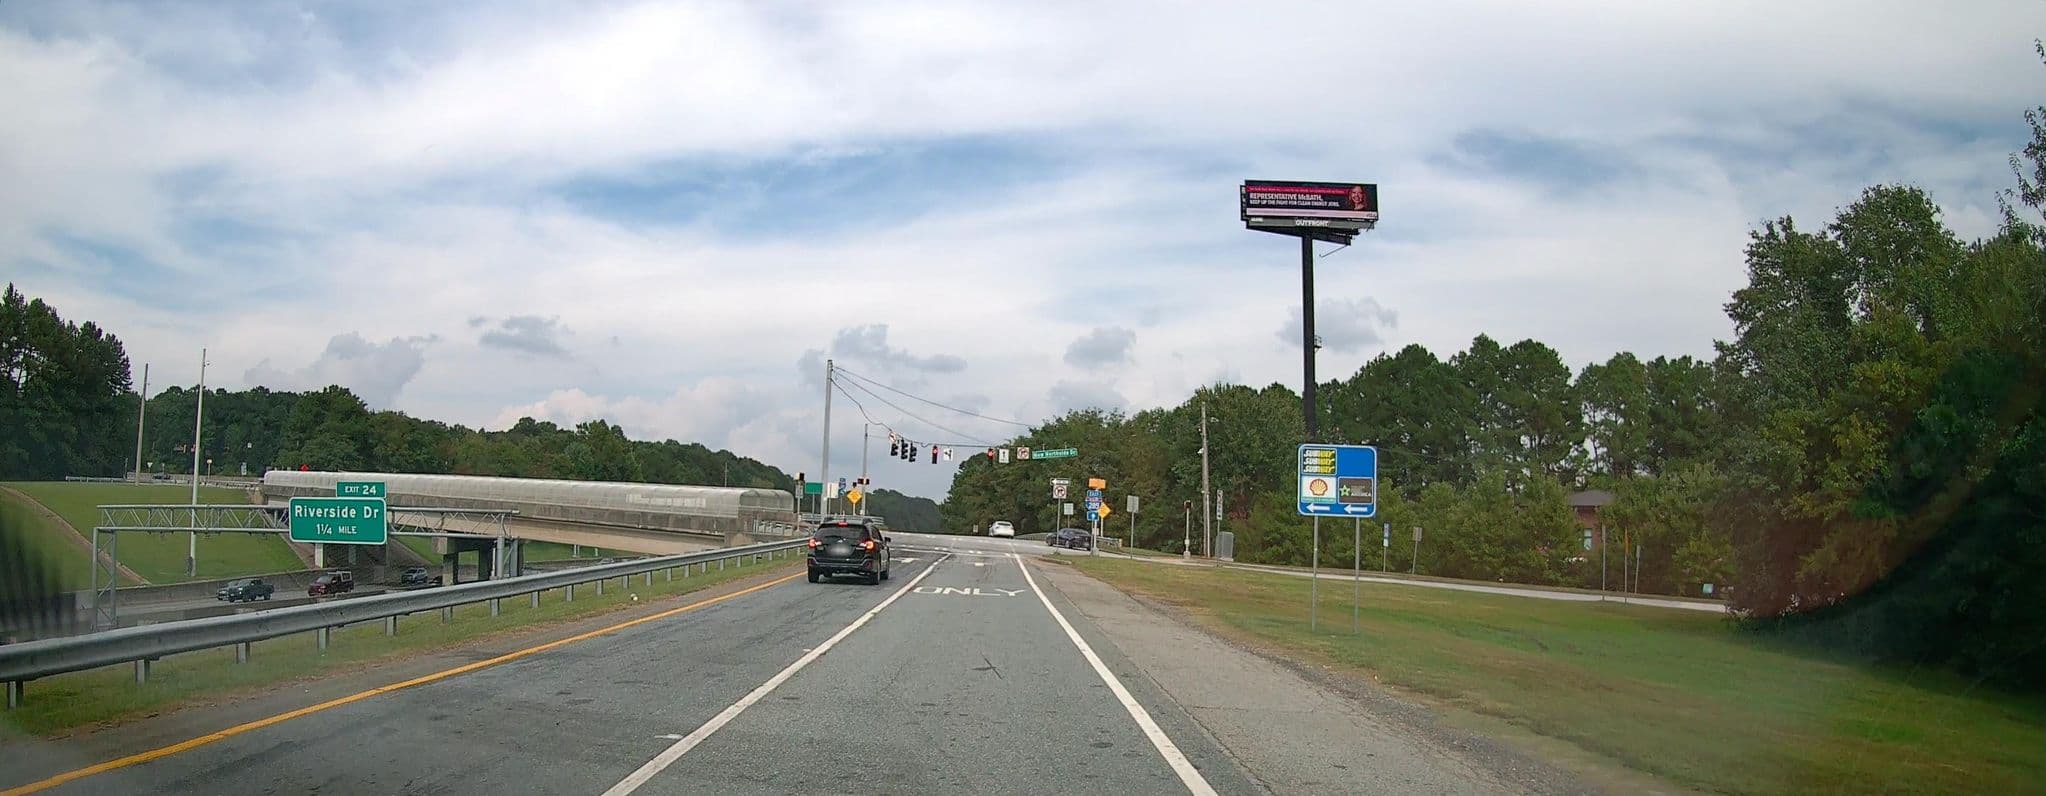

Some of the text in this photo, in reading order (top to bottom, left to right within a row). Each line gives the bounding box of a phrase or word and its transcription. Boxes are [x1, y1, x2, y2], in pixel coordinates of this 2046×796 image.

[362, 485, 376, 495] 24
[295, 505, 379, 519] Riverside Dr
[338, 526, 357, 534] MILE
[912, 587, 1026, 596] ONLY
